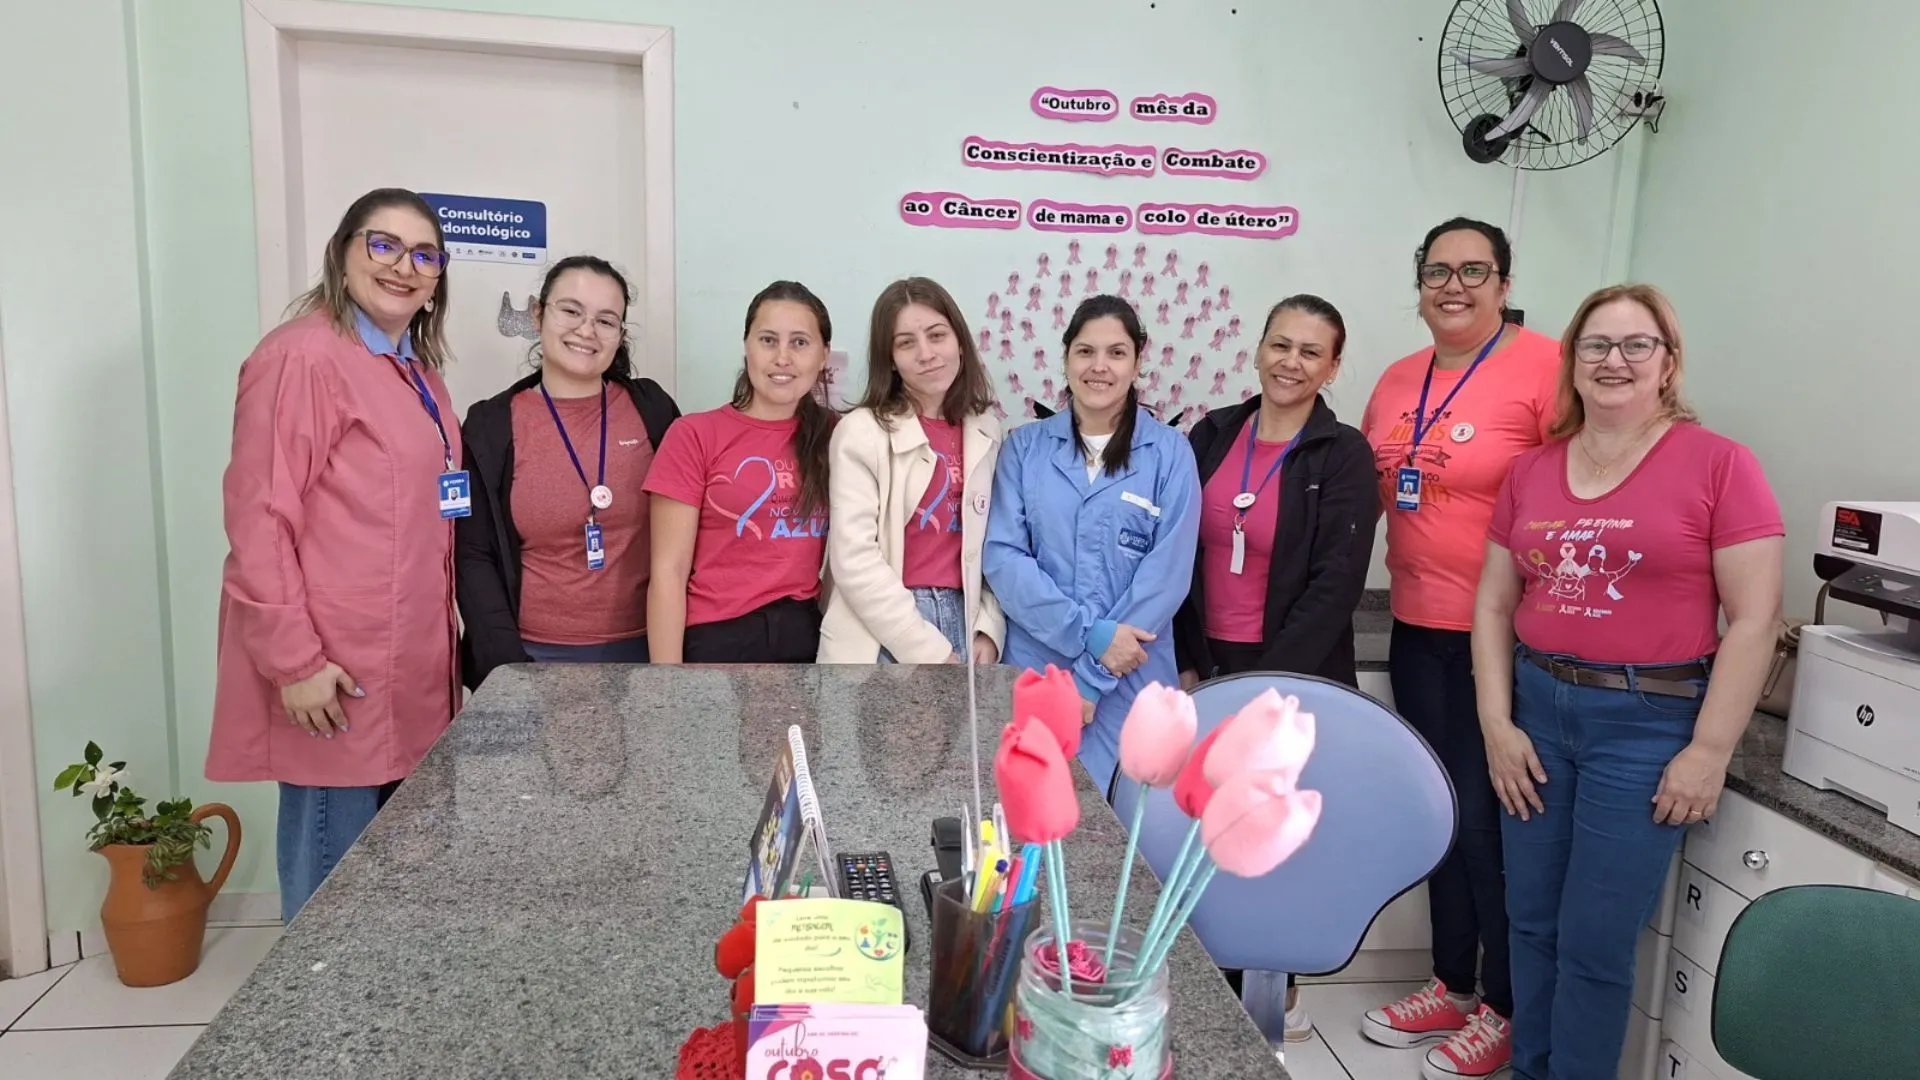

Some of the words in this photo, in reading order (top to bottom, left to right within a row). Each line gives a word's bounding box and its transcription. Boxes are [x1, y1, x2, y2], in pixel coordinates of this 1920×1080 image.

[1136, 101, 1178, 115] mês
[1182, 102, 1208, 115] da
[966, 145, 1136, 169] Conscientização
[1141, 157, 1152, 168] e
[1165, 153, 1256, 169] Combate
[438, 206, 524, 223] Consultório
[904, 201, 930, 213] ao
[943, 200, 1018, 219] Câncer
[1035, 208, 1056, 223] de
[1060, 212, 1111, 225] mama
[1115, 215, 1125, 225] e
[1144, 210, 1186, 223] colo
[1196, 212, 1220, 225] de
[1225, 213, 1290, 227] útero”
[440, 222, 531, 240] dontológico
[771, 517, 828, 538] AZU
[1545, 530, 1556, 541] E
[1856, 704, 1874, 727] hp
[1687, 883, 1701, 911] R
[1674, 970, 1688, 994] S
[764, 1021, 819, 1061] outubro
[1668, 1054, 1681, 1078] T
